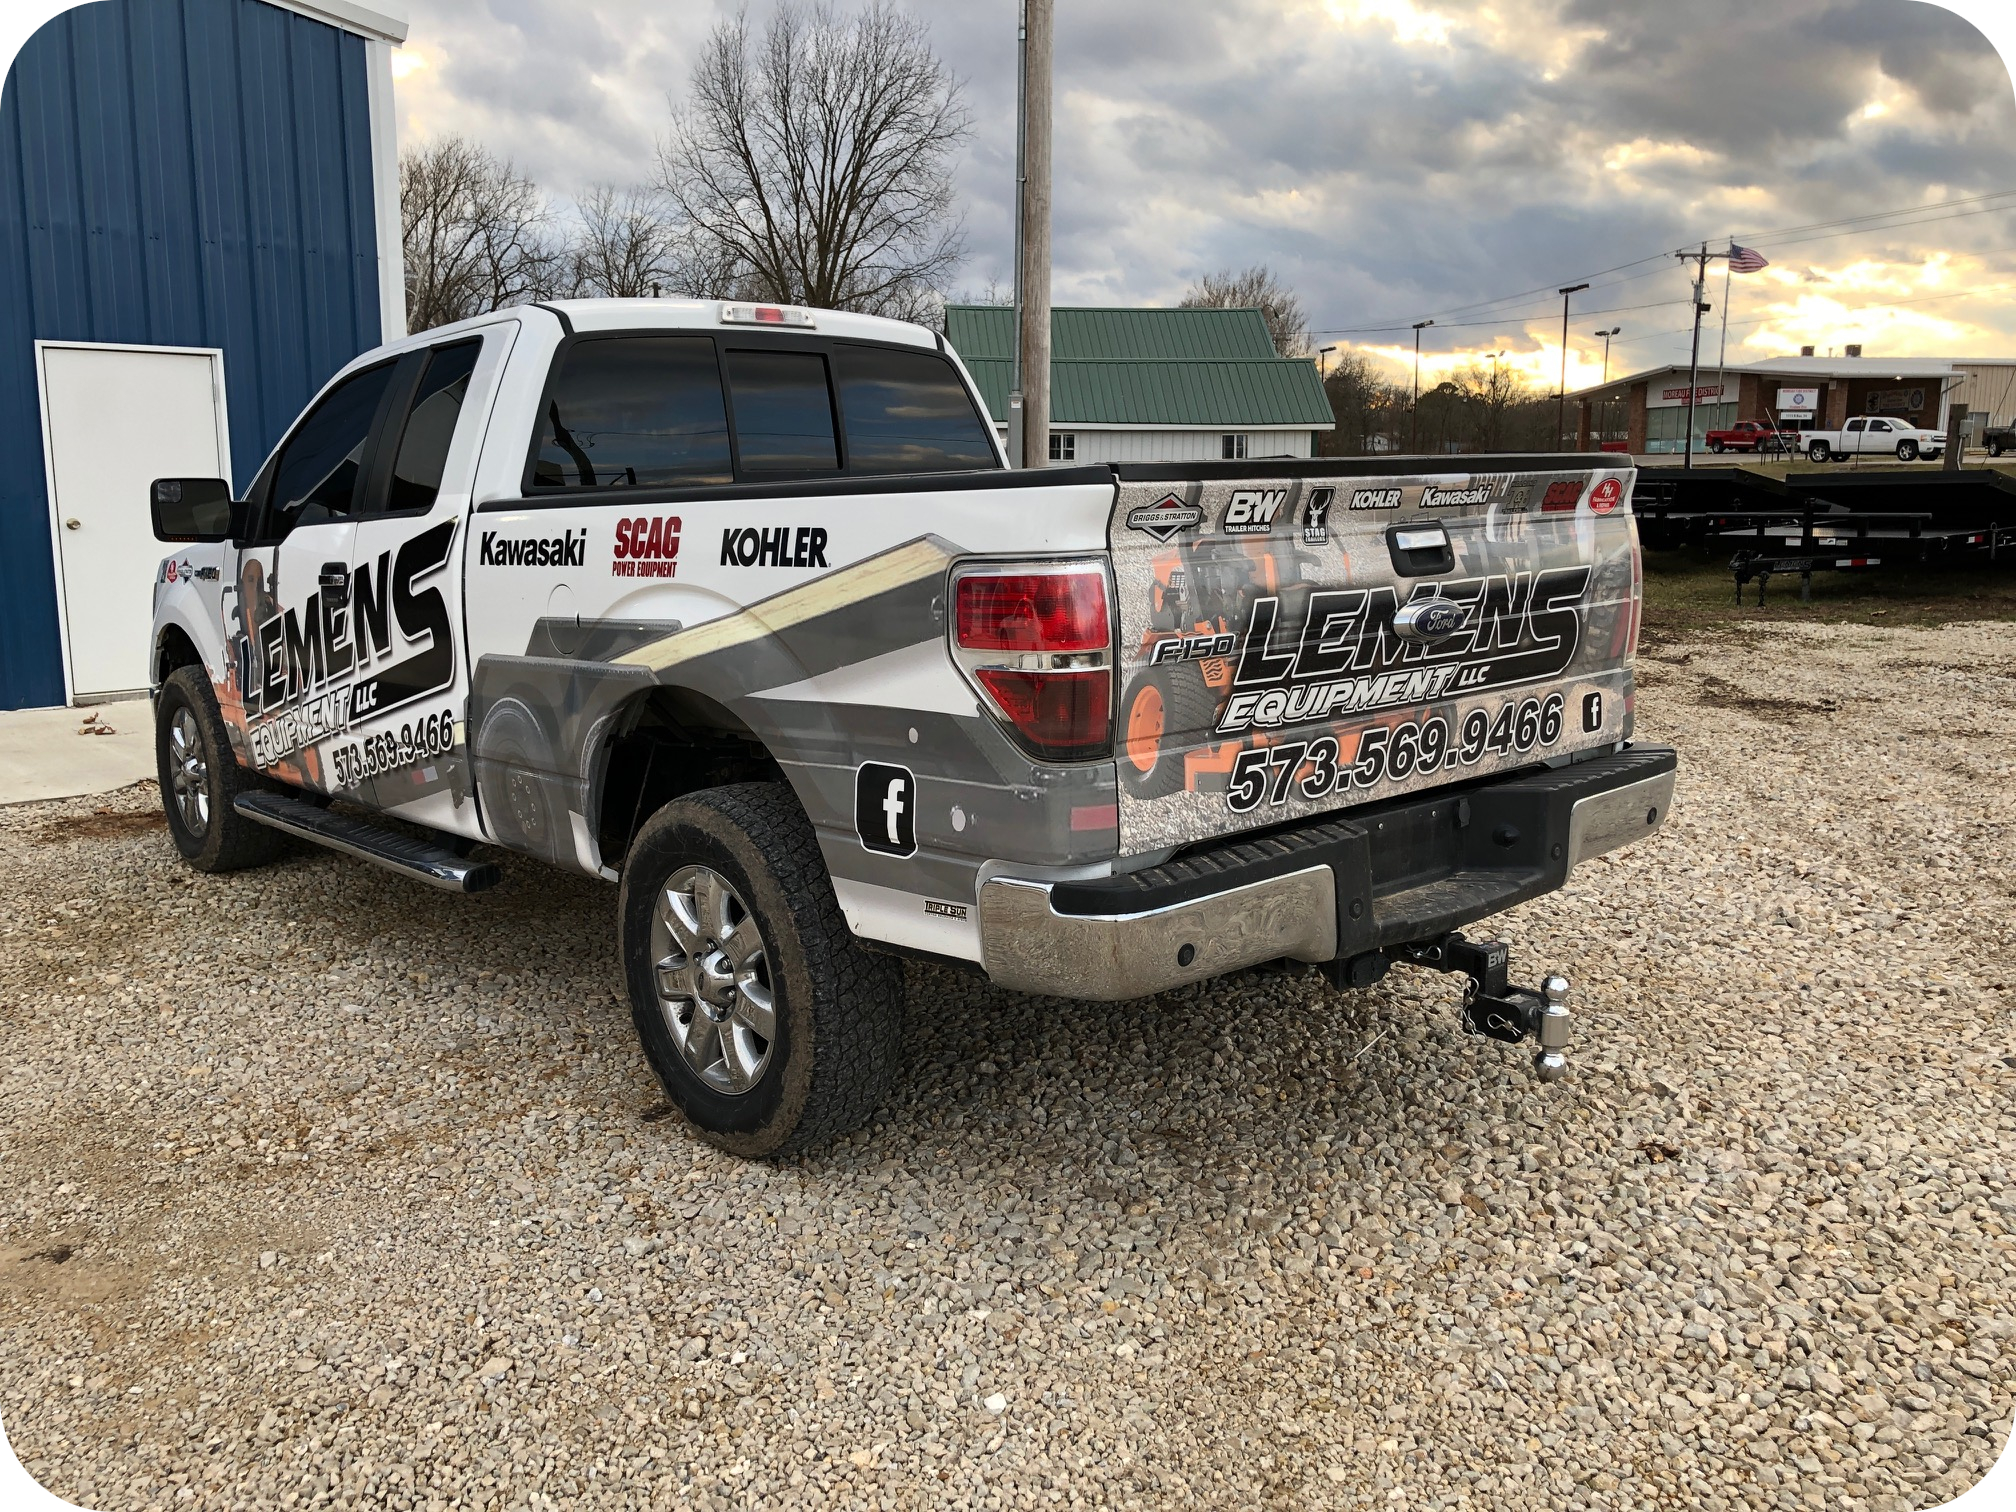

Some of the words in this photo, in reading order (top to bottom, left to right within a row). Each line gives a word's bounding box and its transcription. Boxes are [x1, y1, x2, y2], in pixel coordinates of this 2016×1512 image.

[1350, 490, 1401, 508] KOHLER
[1419, 485, 1493, 507] Kawasaki
[480, 528, 587, 566] Kawasaki
[613, 516, 682, 559] SCAG
[720, 527, 828, 567] KOHLER
[1225, 525, 1247, 533] TRAILER
[1248, 524, 1270, 532] HITCHES
[1304, 528, 1326, 538] STAG
[612, 561, 635, 577] POWER
[637, 561, 677, 578] EQUIPMENT
[240, 515, 459, 724] LEMENS
[1234, 565, 1591, 690] LEMENS
[1427, 609, 1456, 631] Ford
[1217, 664, 1457, 733] EQUIPMENT
[1458, 665, 1488, 685] LLC
[249, 684, 352, 770] EQUIPMENT
[356, 681, 377, 713] LLC
[332, 708, 454, 786] 573.569.9466
[1227, 693, 1563, 814] 573.569.9466
[924, 900, 949, 914] TRIPLE
[950, 905, 967, 918] SUN
